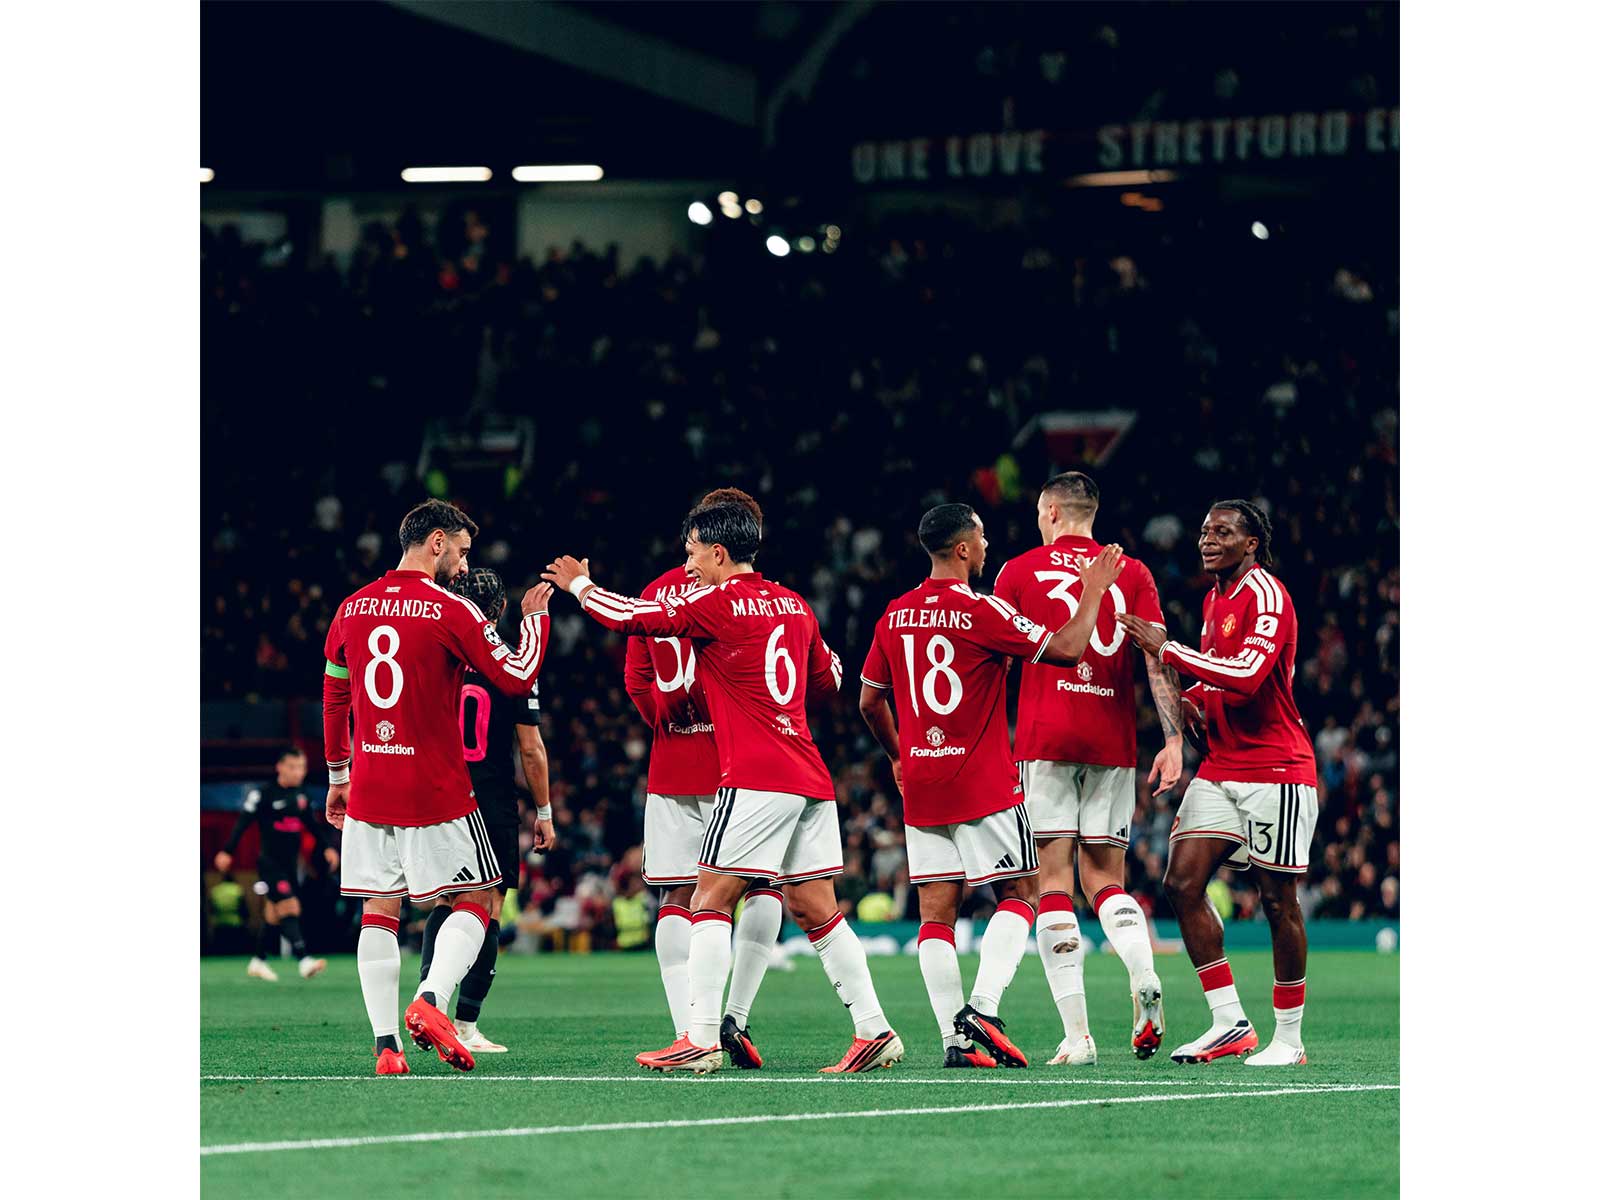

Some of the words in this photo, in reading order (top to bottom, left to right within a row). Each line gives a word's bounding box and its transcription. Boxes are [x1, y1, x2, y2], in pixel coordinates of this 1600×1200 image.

[852, 139, 930, 184] ONE
[945, 131, 1045, 178] LOVE
[1097, 111, 1351, 169] STRETFORD
[344, 598, 443, 620] B.FERNANDES
[889, 608, 973, 630] TIELEMANS
[1034, 571, 1127, 657] 30
[364, 625, 404, 709] 8
[764, 624, 797, 706] 6
[901, 634, 963, 718] 18
[1056, 679, 1114, 697] Foundation
[1247, 819, 1275, 855] 13
